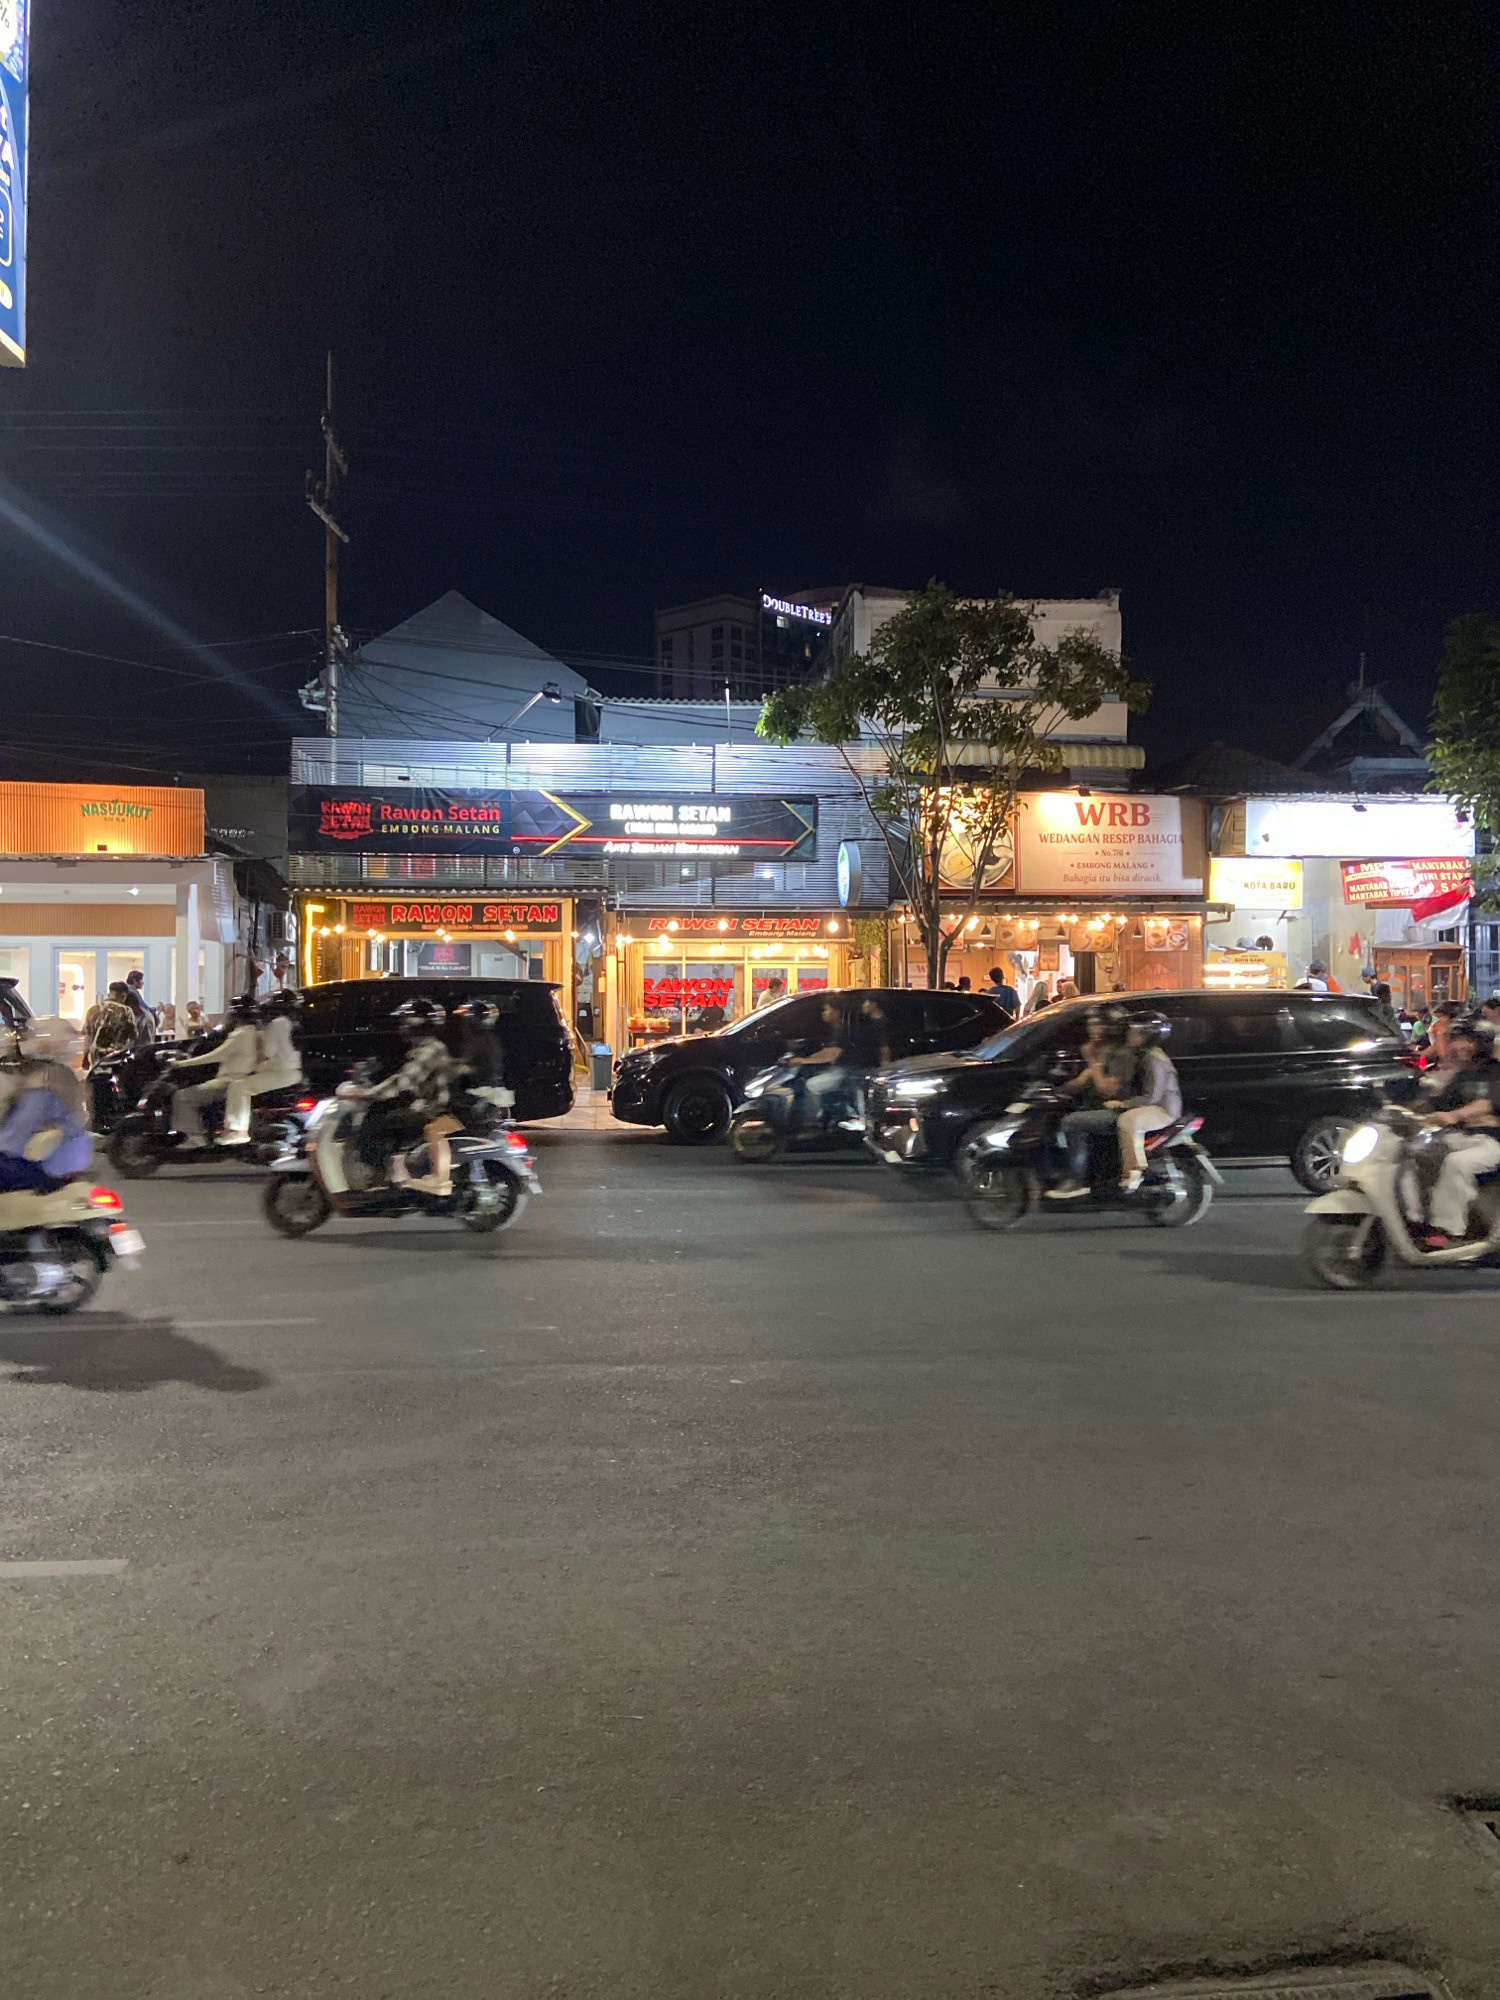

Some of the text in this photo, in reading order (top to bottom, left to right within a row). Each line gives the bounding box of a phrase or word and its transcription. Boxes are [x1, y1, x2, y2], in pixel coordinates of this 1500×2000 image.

[380, 805, 501, 821] Rawon Setan
[678, 806, 731, 822] SETAN
[1075, 802, 1151, 827] WRB
[381, 824, 500, 834] EMBONG MALANG
[1039, 833, 1184, 844] WEDANGAN RESEP BAHAGIA
[1412, 861, 1465, 870] MARTABAK
[1063, 873, 1097, 884] Bahagia
[1099, 873, 1112, 882] itu
[1114, 873, 1130, 882] bisa
[1416, 872, 1438, 880] MINI
[1243, 881, 1296, 890] KOTA BARU
[1349, 881, 1389, 893] MARTABAK
[1349, 890, 1389, 901] MARTABAK
[391, 905, 558, 923] RAWON SETAN
[649, 917, 821, 930] RAWON SETAN
[749, 930, 784, 938] Embong
[644, 978, 733, 992] RAWON
[644, 993, 730, 1007] SETAN
